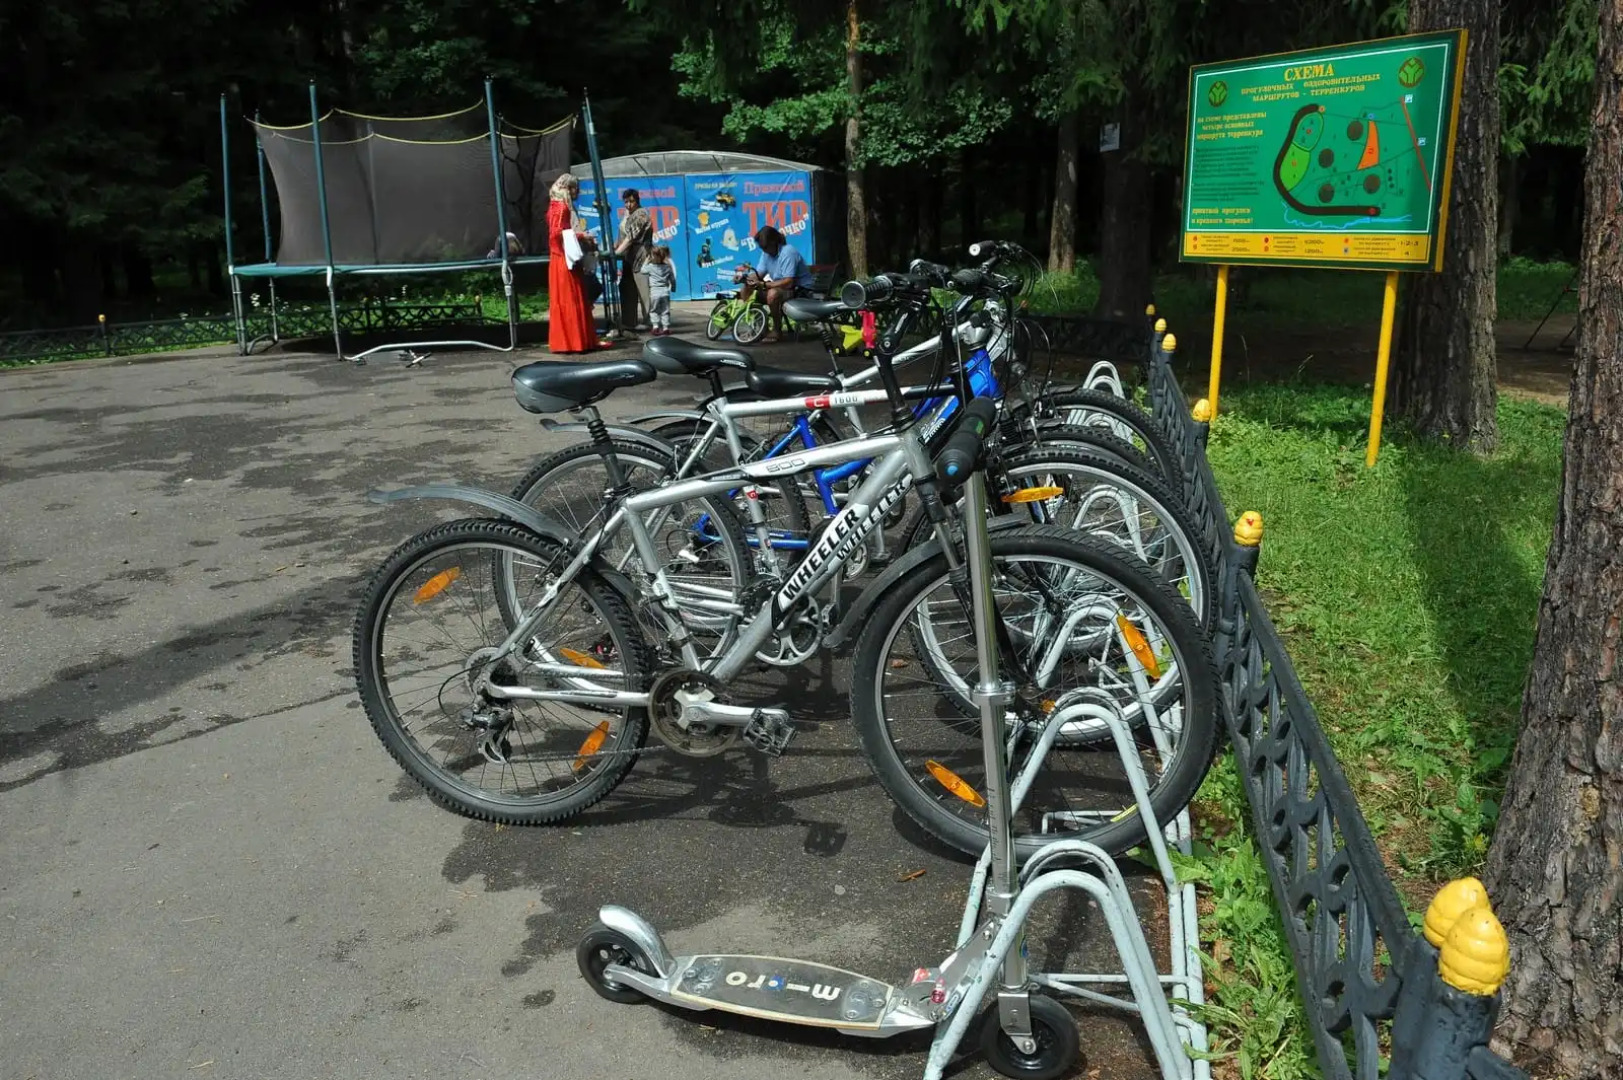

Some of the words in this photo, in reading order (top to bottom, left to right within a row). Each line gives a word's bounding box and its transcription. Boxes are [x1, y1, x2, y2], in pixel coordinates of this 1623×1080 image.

[1284, 63, 1334, 81] СХЕМА
[1252, 91, 1299, 102] МАРШРУТОВ
[1310, 85, 1365, 96] ТЕРРЕНКУРОВ
[742, 200, 809, 239] ТИР
[836, 481, 907, 561] WHEELER
[782, 508, 861, 601] WHEELER
